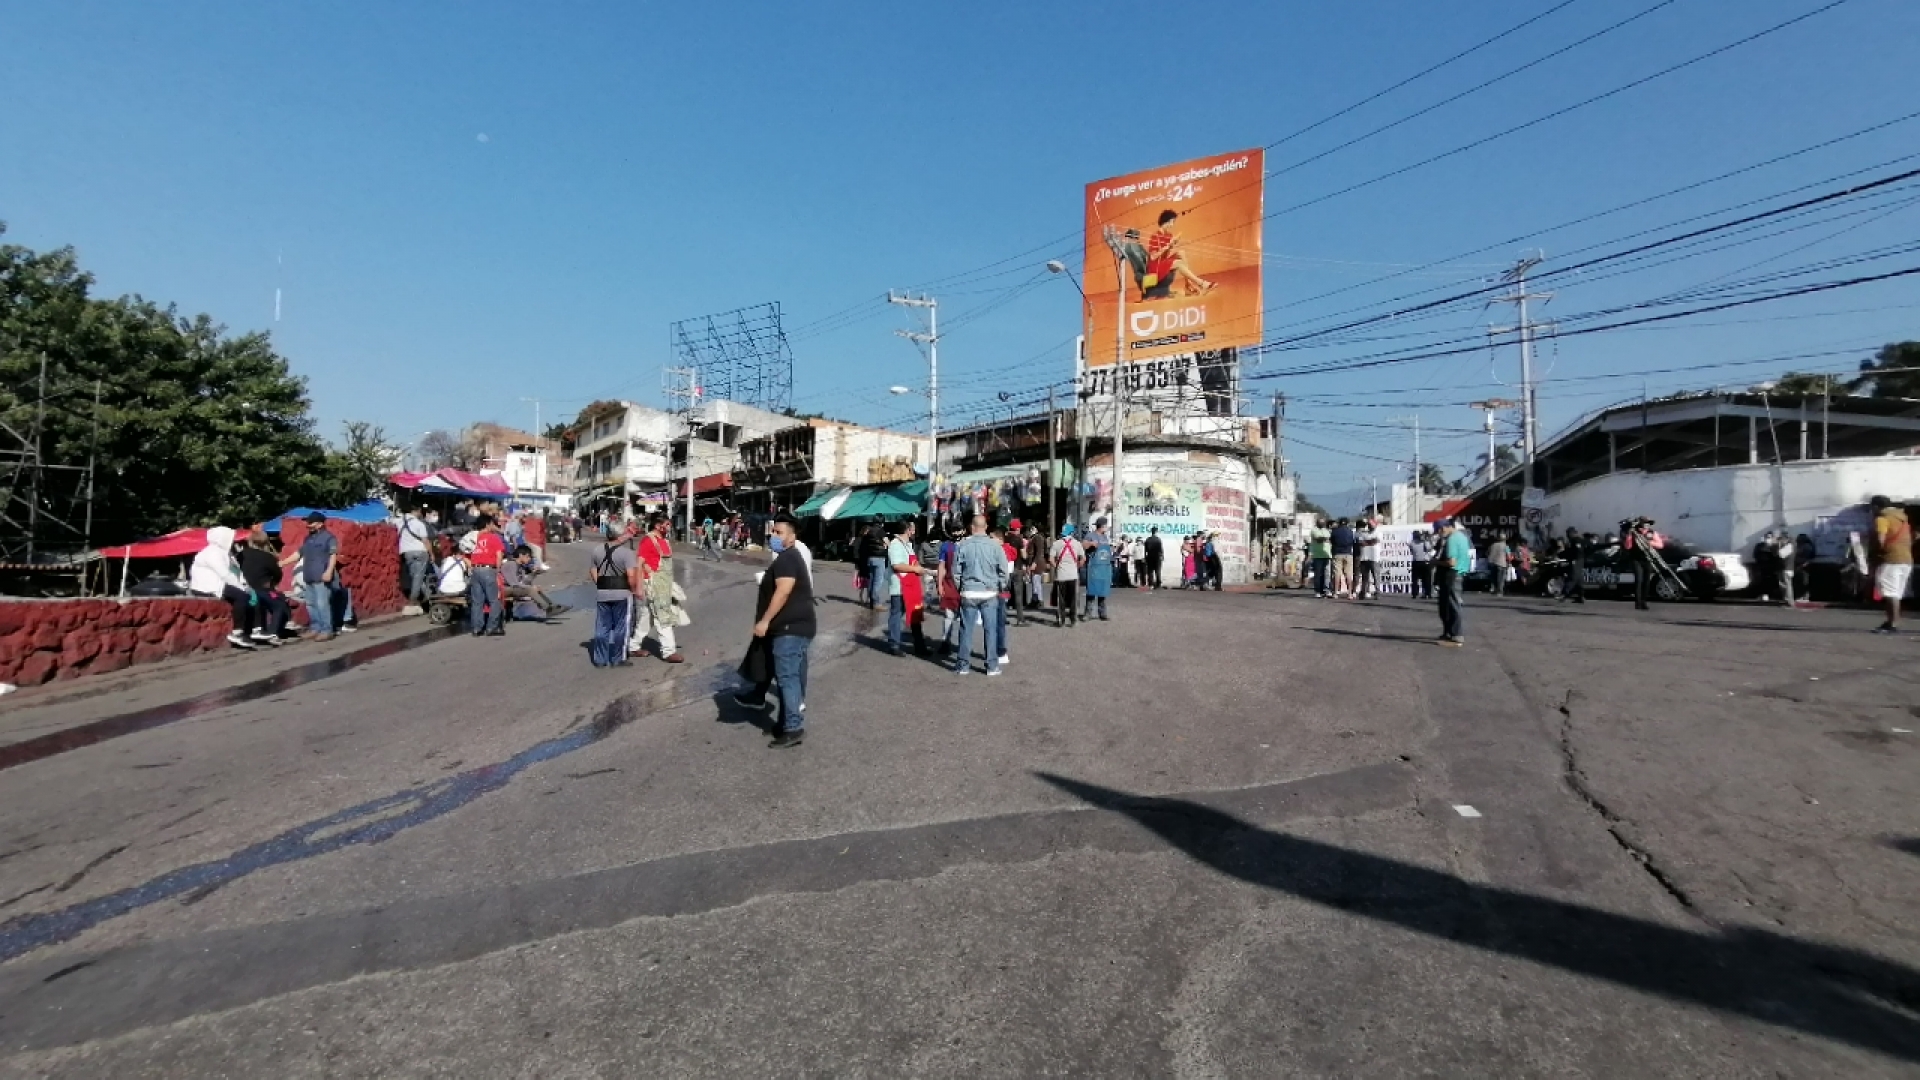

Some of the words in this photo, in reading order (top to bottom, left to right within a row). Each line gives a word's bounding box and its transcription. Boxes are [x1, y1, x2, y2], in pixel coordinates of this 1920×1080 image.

[1095, 187, 1111, 203] ¿Te
[1112, 184, 1137, 199] urge
[1137, 179, 1154, 192] ver
[1156, 179, 1162, 187] a
[1163, 156, 1249, 188] ya-sabes-quién?
[1163, 305, 1207, 331] DiDi
[1499, 515, 1517, 526] DE
